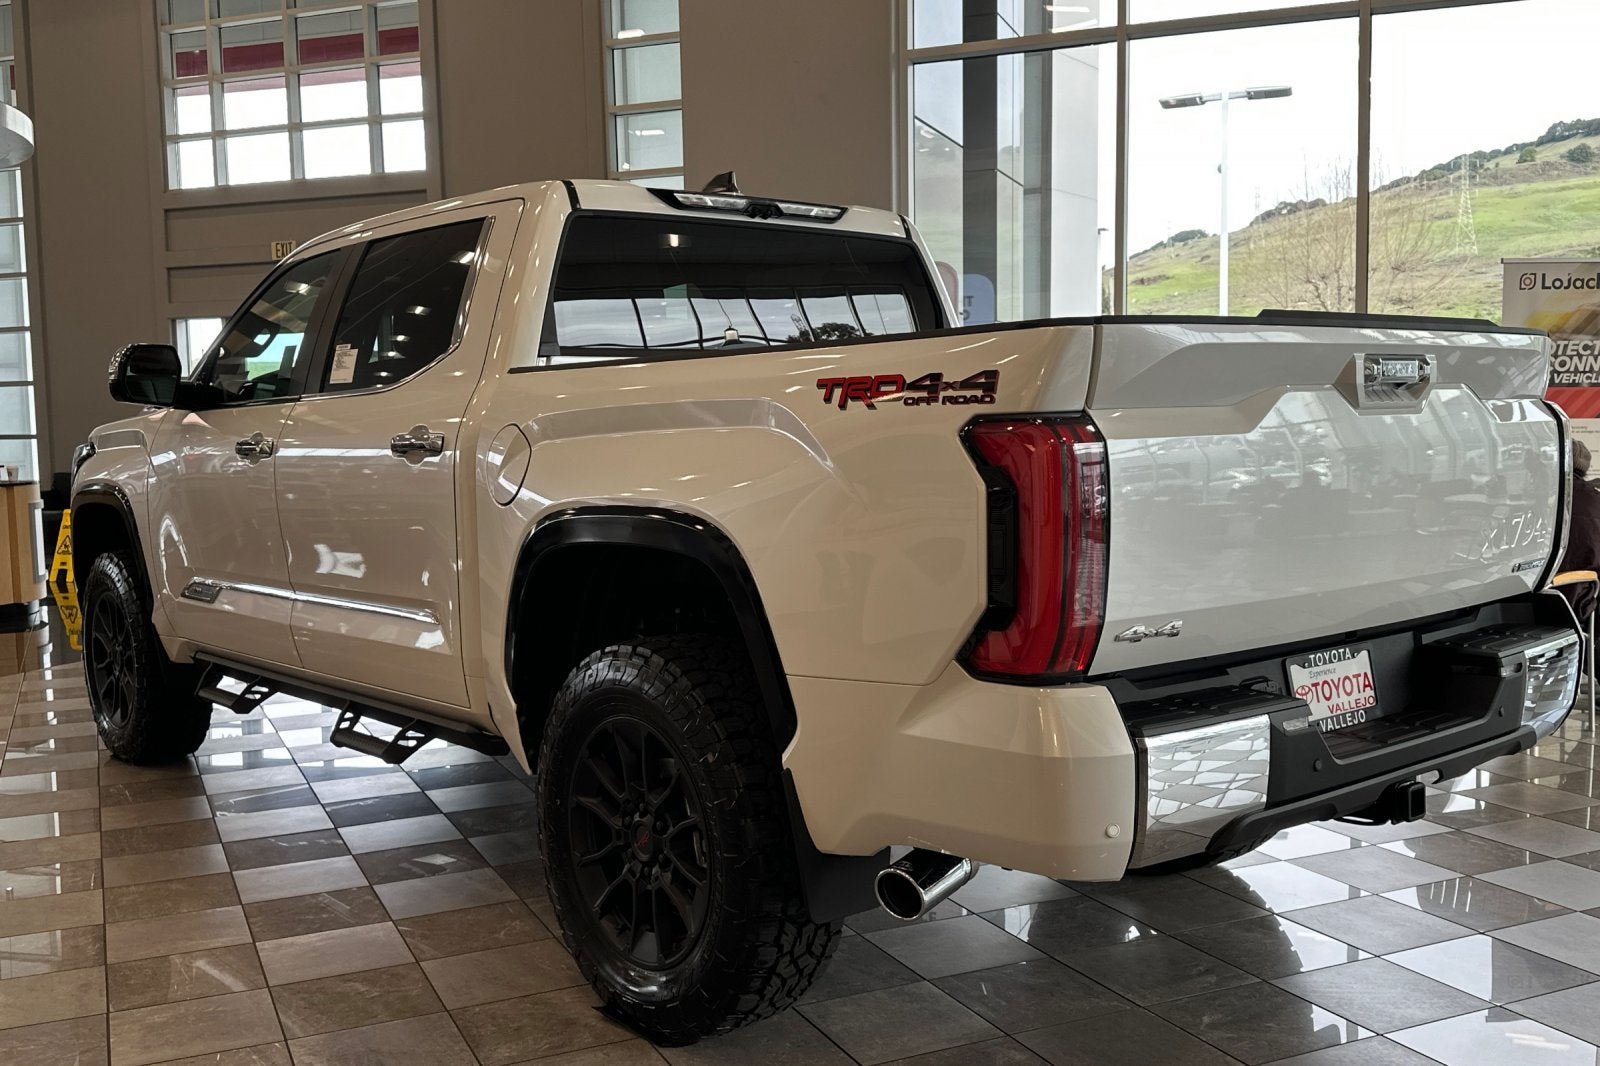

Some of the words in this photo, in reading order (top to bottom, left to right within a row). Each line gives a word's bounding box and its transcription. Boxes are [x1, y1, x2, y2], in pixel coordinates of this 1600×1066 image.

[275, 242, 292, 258] EXIT
[1553, 373, 1600, 384] VEHICL
[816, 374, 905, 410] TRD
[905, 369, 1000, 395] 4x4
[903, 396, 939, 406] OFF
[942, 394, 996, 406] ROAD
[1114, 619, 1182, 642] 4x4
[1309, 648, 1351, 666] TOYOTA
[1309, 667, 1336, 678] Experience
[1311, 672, 1373, 703] TOYOTA
[1328, 695, 1376, 714] VALLEJO
[1320, 710, 1366, 732] VALLEJO
